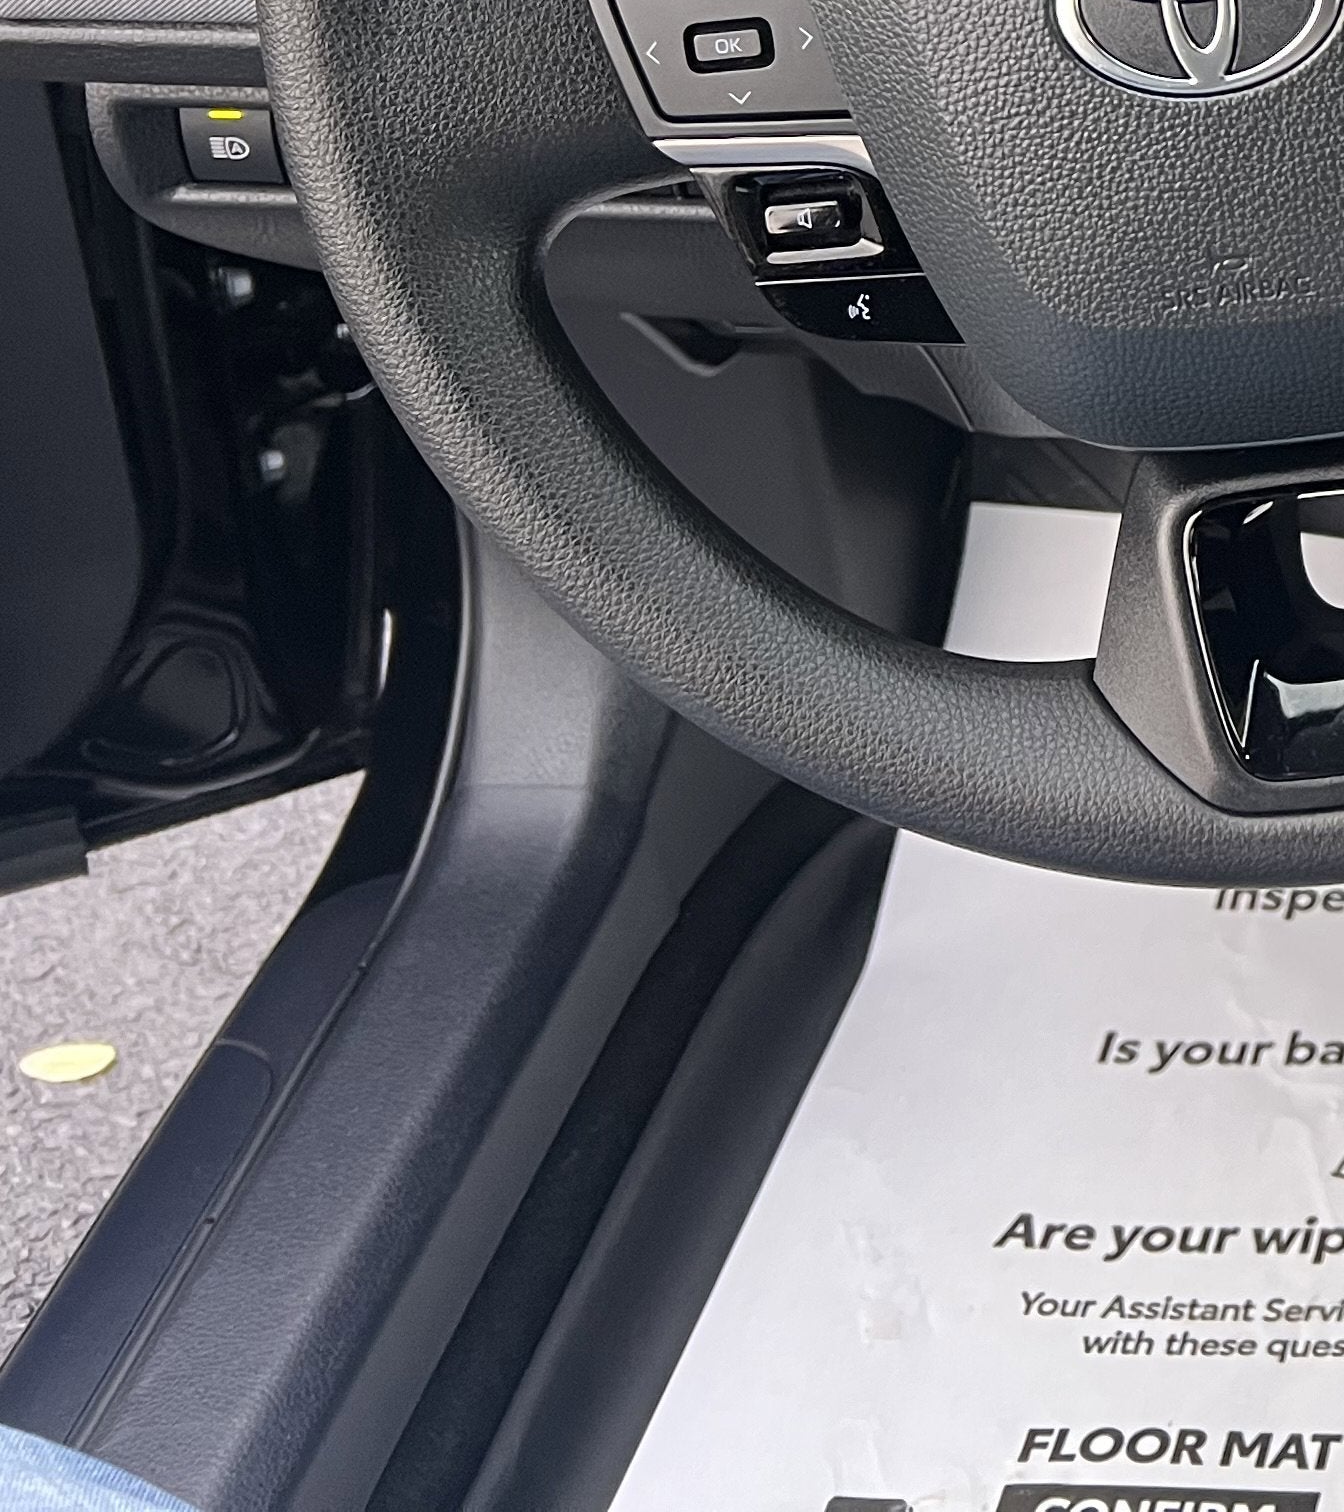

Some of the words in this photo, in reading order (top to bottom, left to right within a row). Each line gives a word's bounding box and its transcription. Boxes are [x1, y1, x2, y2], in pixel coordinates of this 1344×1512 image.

[715, 37, 742, 55] OK
[1097, 1031, 1141, 1066] Is
[1149, 1038, 1274, 1074] your
[992, 1213, 1097, 1251] Are
[1103, 1221, 1240, 1262] your
[1020, 1290, 1097, 1321] Your
[1100, 1294, 1256, 1324] Assistant
[1082, 1329, 1154, 1358] with
[1165, 1331, 1257, 1359] these
[1017, 1427, 1204, 1467] FLOOR
[1219, 1431, 1343, 1472] MAT
